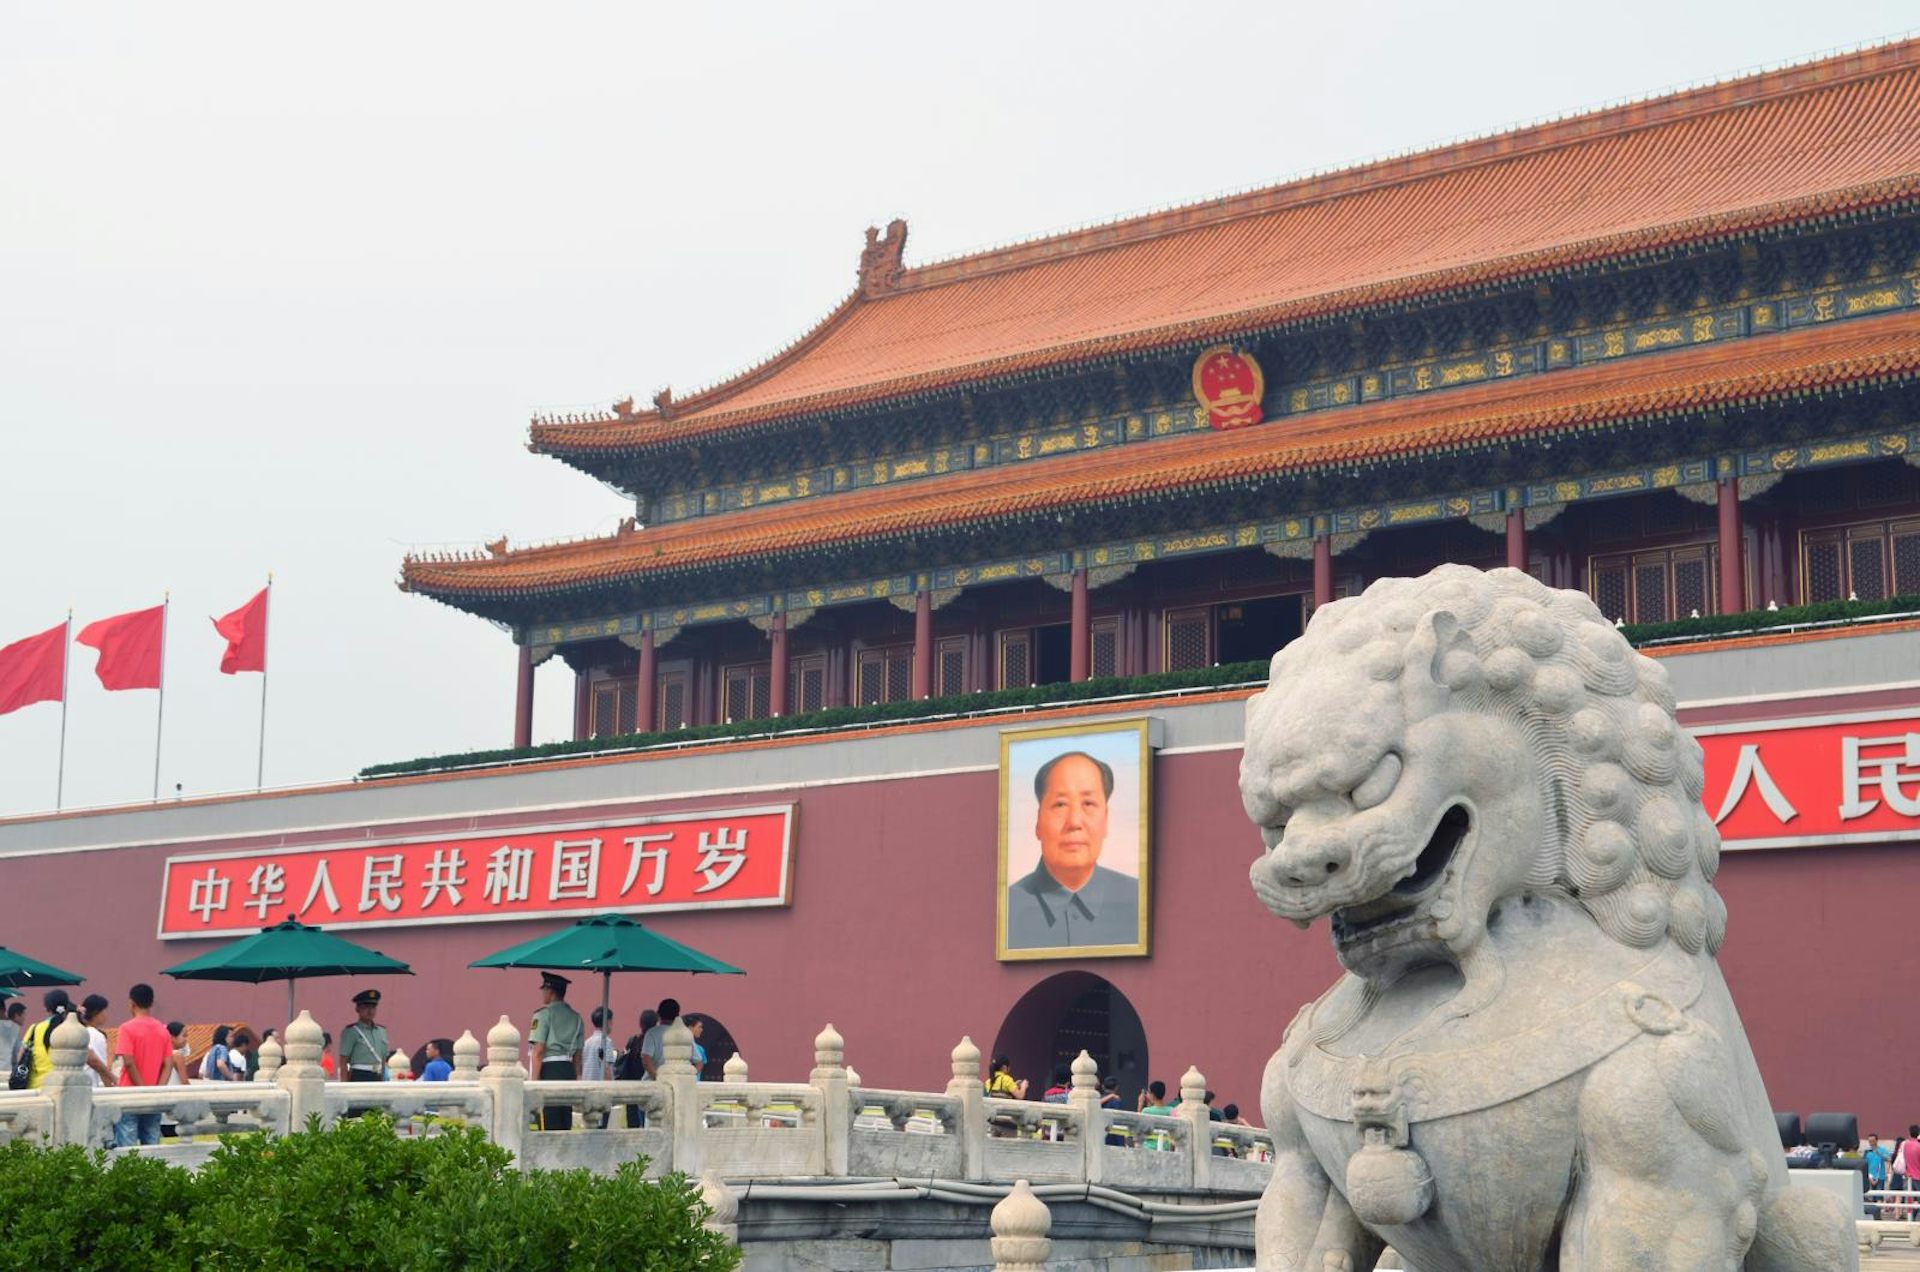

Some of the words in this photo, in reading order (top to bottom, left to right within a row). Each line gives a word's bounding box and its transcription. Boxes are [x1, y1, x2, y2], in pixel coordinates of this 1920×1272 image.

[1714, 732, 1920, 826] 人民
[188, 827, 749, 923] 中华人民共和国万岁
